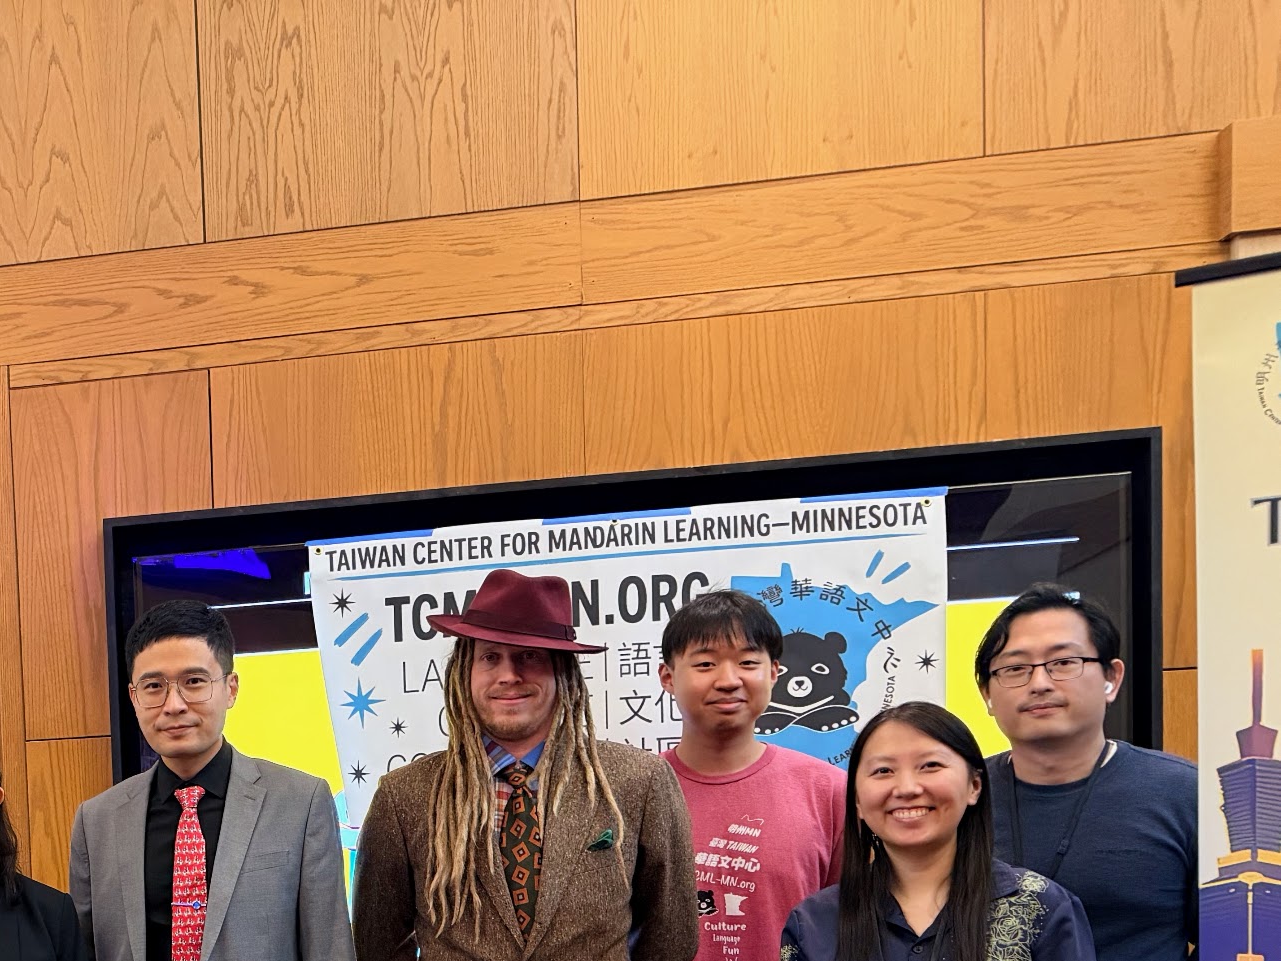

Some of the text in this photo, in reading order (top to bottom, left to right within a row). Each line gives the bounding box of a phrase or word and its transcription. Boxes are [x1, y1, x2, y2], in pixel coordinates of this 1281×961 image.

[325, 543, 407, 573] TAIWAN
[413, 536, 496, 564] CENTER
[500, 531, 541, 557] FOR
[548, 520, 657, 552] MANDARIN
[384, 571, 711, 643] TCMN.ORG
[757, 577, 901, 674] 灣華語文中心
[880, 675, 896, 713] NESOTA
[827, 747, 854, 766] LEAR
[695, 870, 756, 892] CML-MN.org
[704, 921, 747, 932] Culture
[712, 933, 741, 944] Language
[722, 945, 740, 955] Fun
